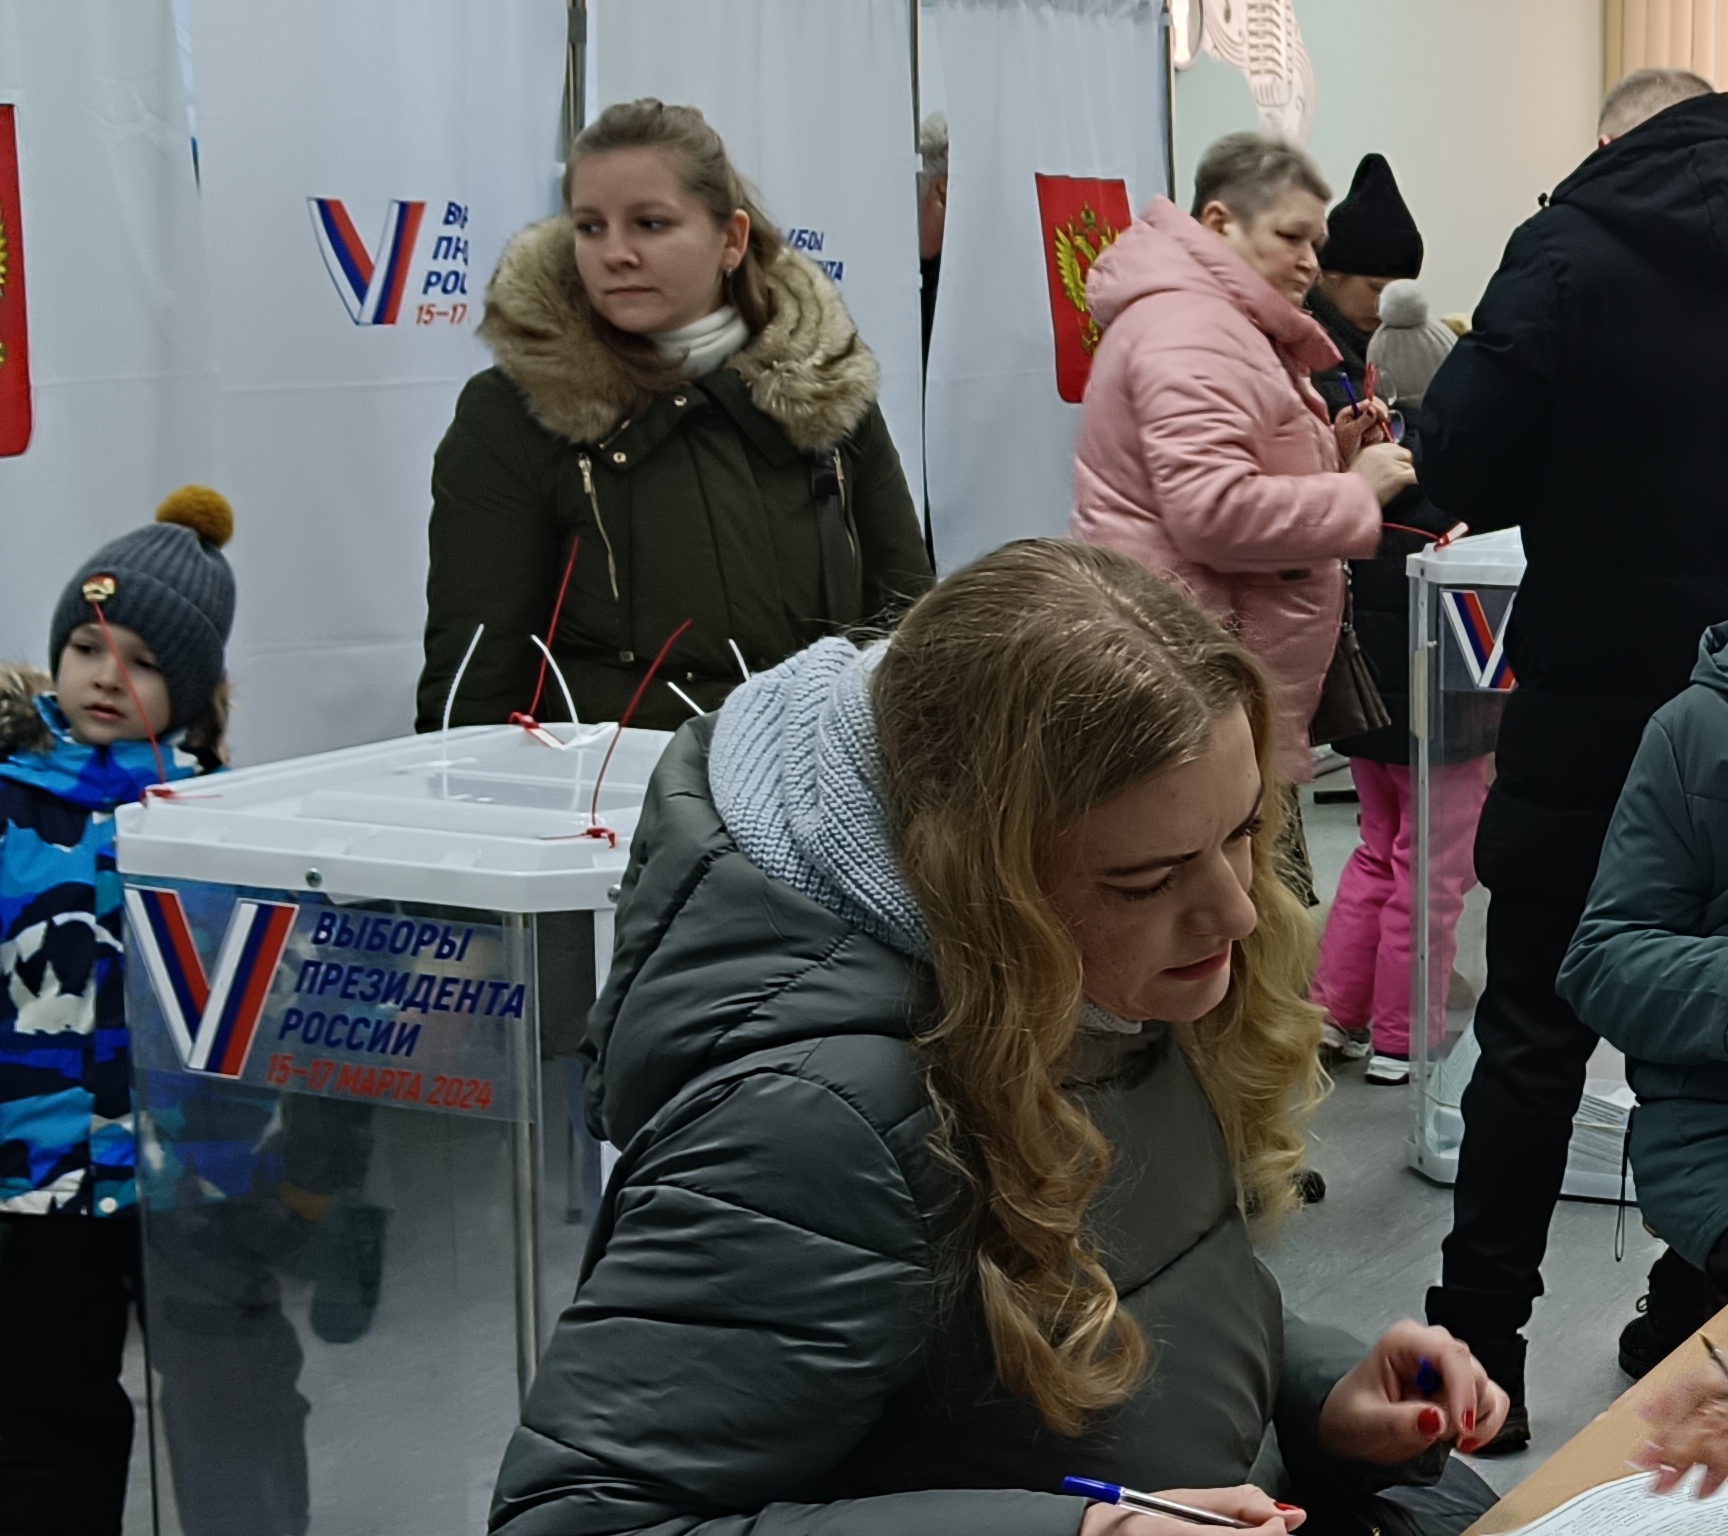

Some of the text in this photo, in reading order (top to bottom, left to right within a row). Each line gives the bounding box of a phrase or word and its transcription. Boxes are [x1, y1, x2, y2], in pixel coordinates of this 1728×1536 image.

[312, 911, 474, 962] ВЫБОРЫ
[295, 960, 526, 1019] ПРЕЗИДЕНТА
[278, 1008, 422, 1057] РОССИИ
[335, 1064, 423, 1102] МАРТА
[425, 1075, 493, 1111] 2024
